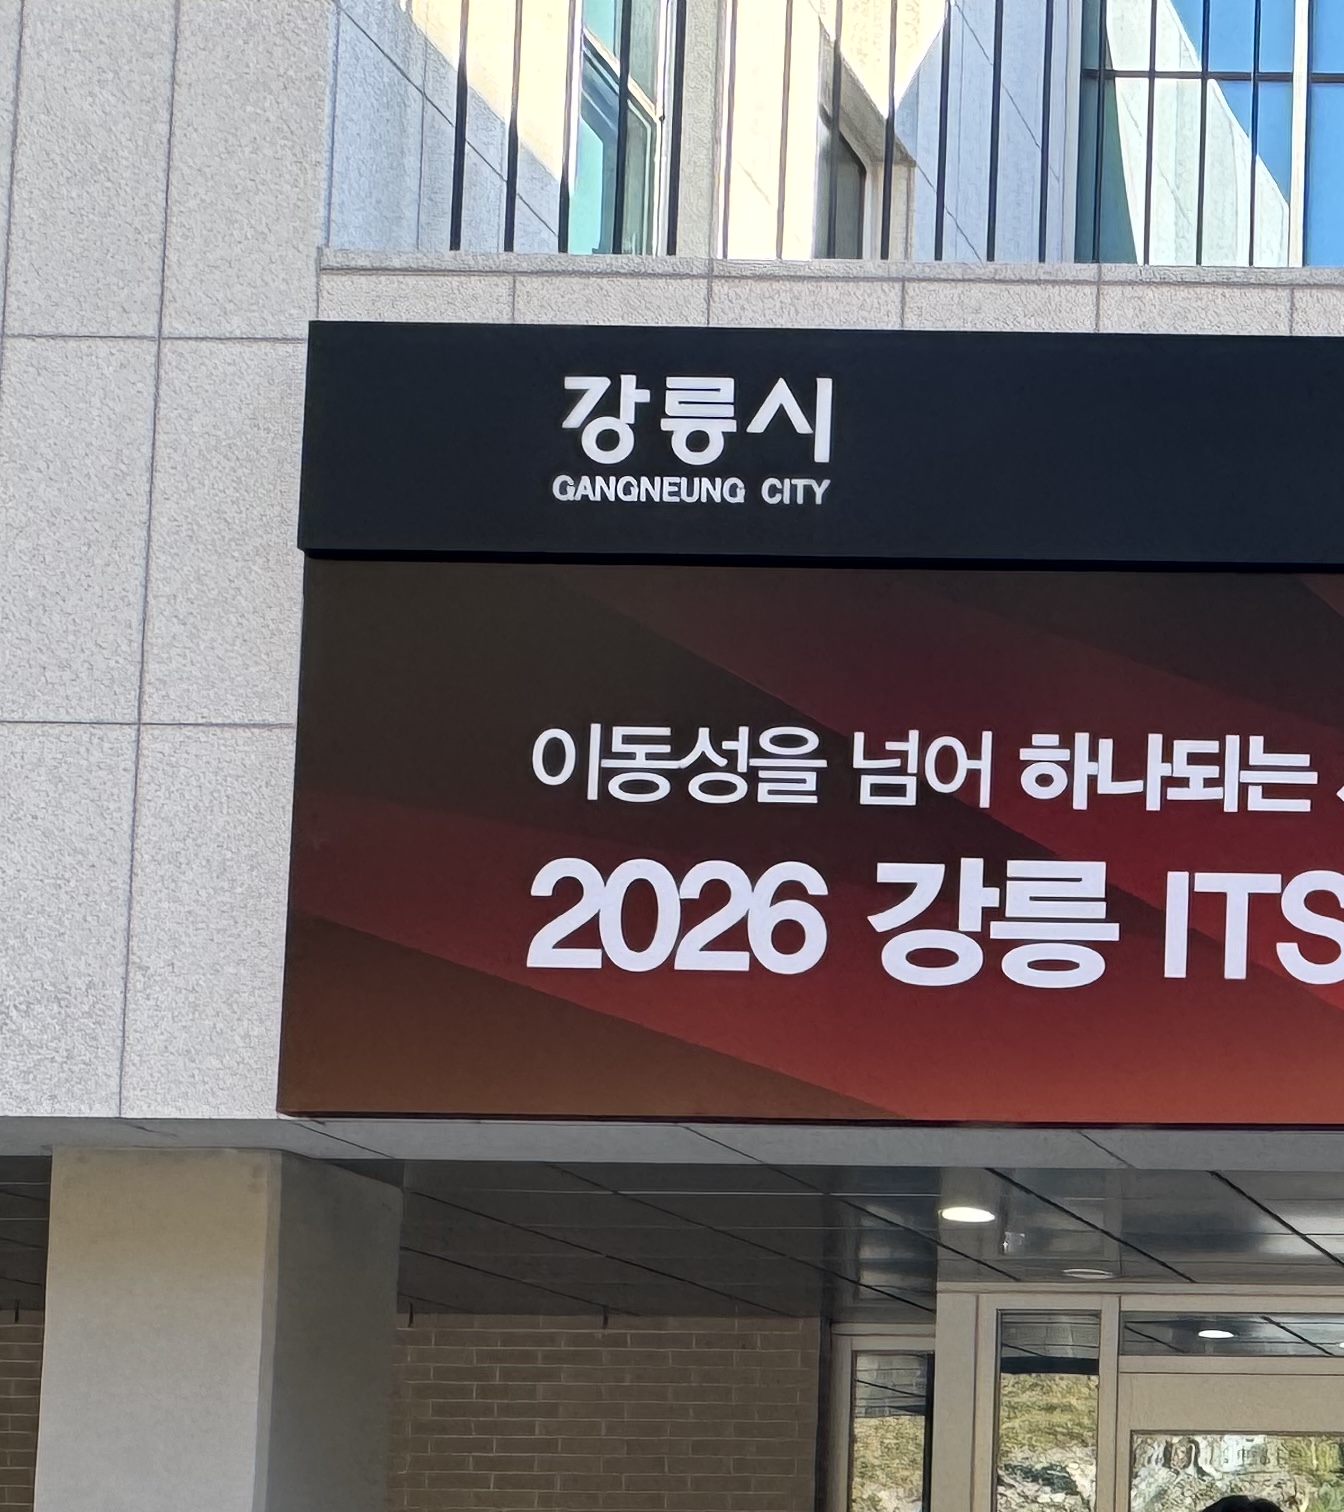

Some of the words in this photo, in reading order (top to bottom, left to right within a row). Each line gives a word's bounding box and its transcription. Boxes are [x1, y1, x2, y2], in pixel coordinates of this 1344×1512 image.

[561, 374, 833, 466] 강릉시
[552, 474, 746, 504] GANGNEUNG
[761, 477, 831, 505] CITY
[532, 723, 828, 804] 이동성을
[852, 729, 993, 809] 넘어
[1019, 732, 1318, 813] 하나되는
[526, 857, 829, 975] 2026
[866, 857, 1120, 989] 강릉
